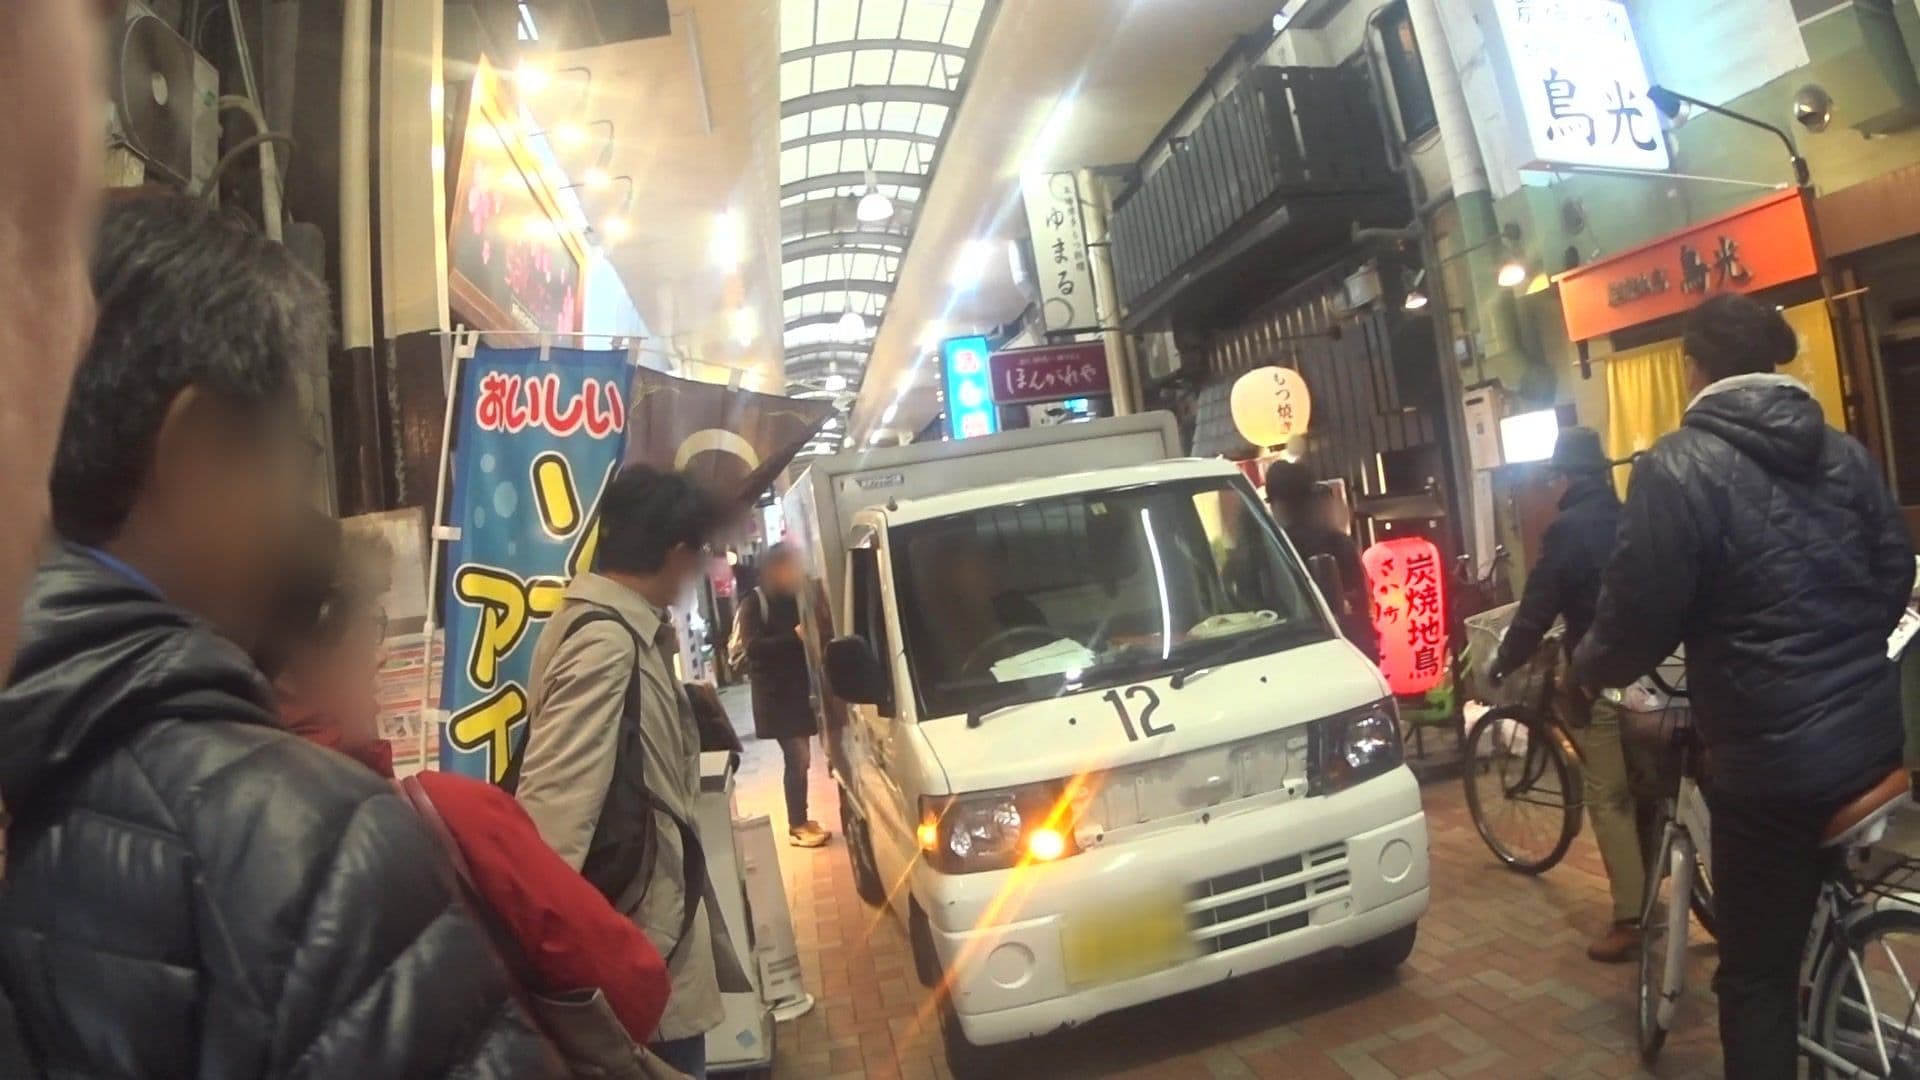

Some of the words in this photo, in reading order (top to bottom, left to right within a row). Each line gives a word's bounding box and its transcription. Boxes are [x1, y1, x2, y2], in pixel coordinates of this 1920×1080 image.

[1543, 67, 1658, 151] 鳥光
[1046, 207, 1074, 295] ゆまる
[475, 371, 627, 439] おいしい
[1404, 553, 1441, 680] 炭焼地鳥
[1102, 685, 1176, 742] 12
